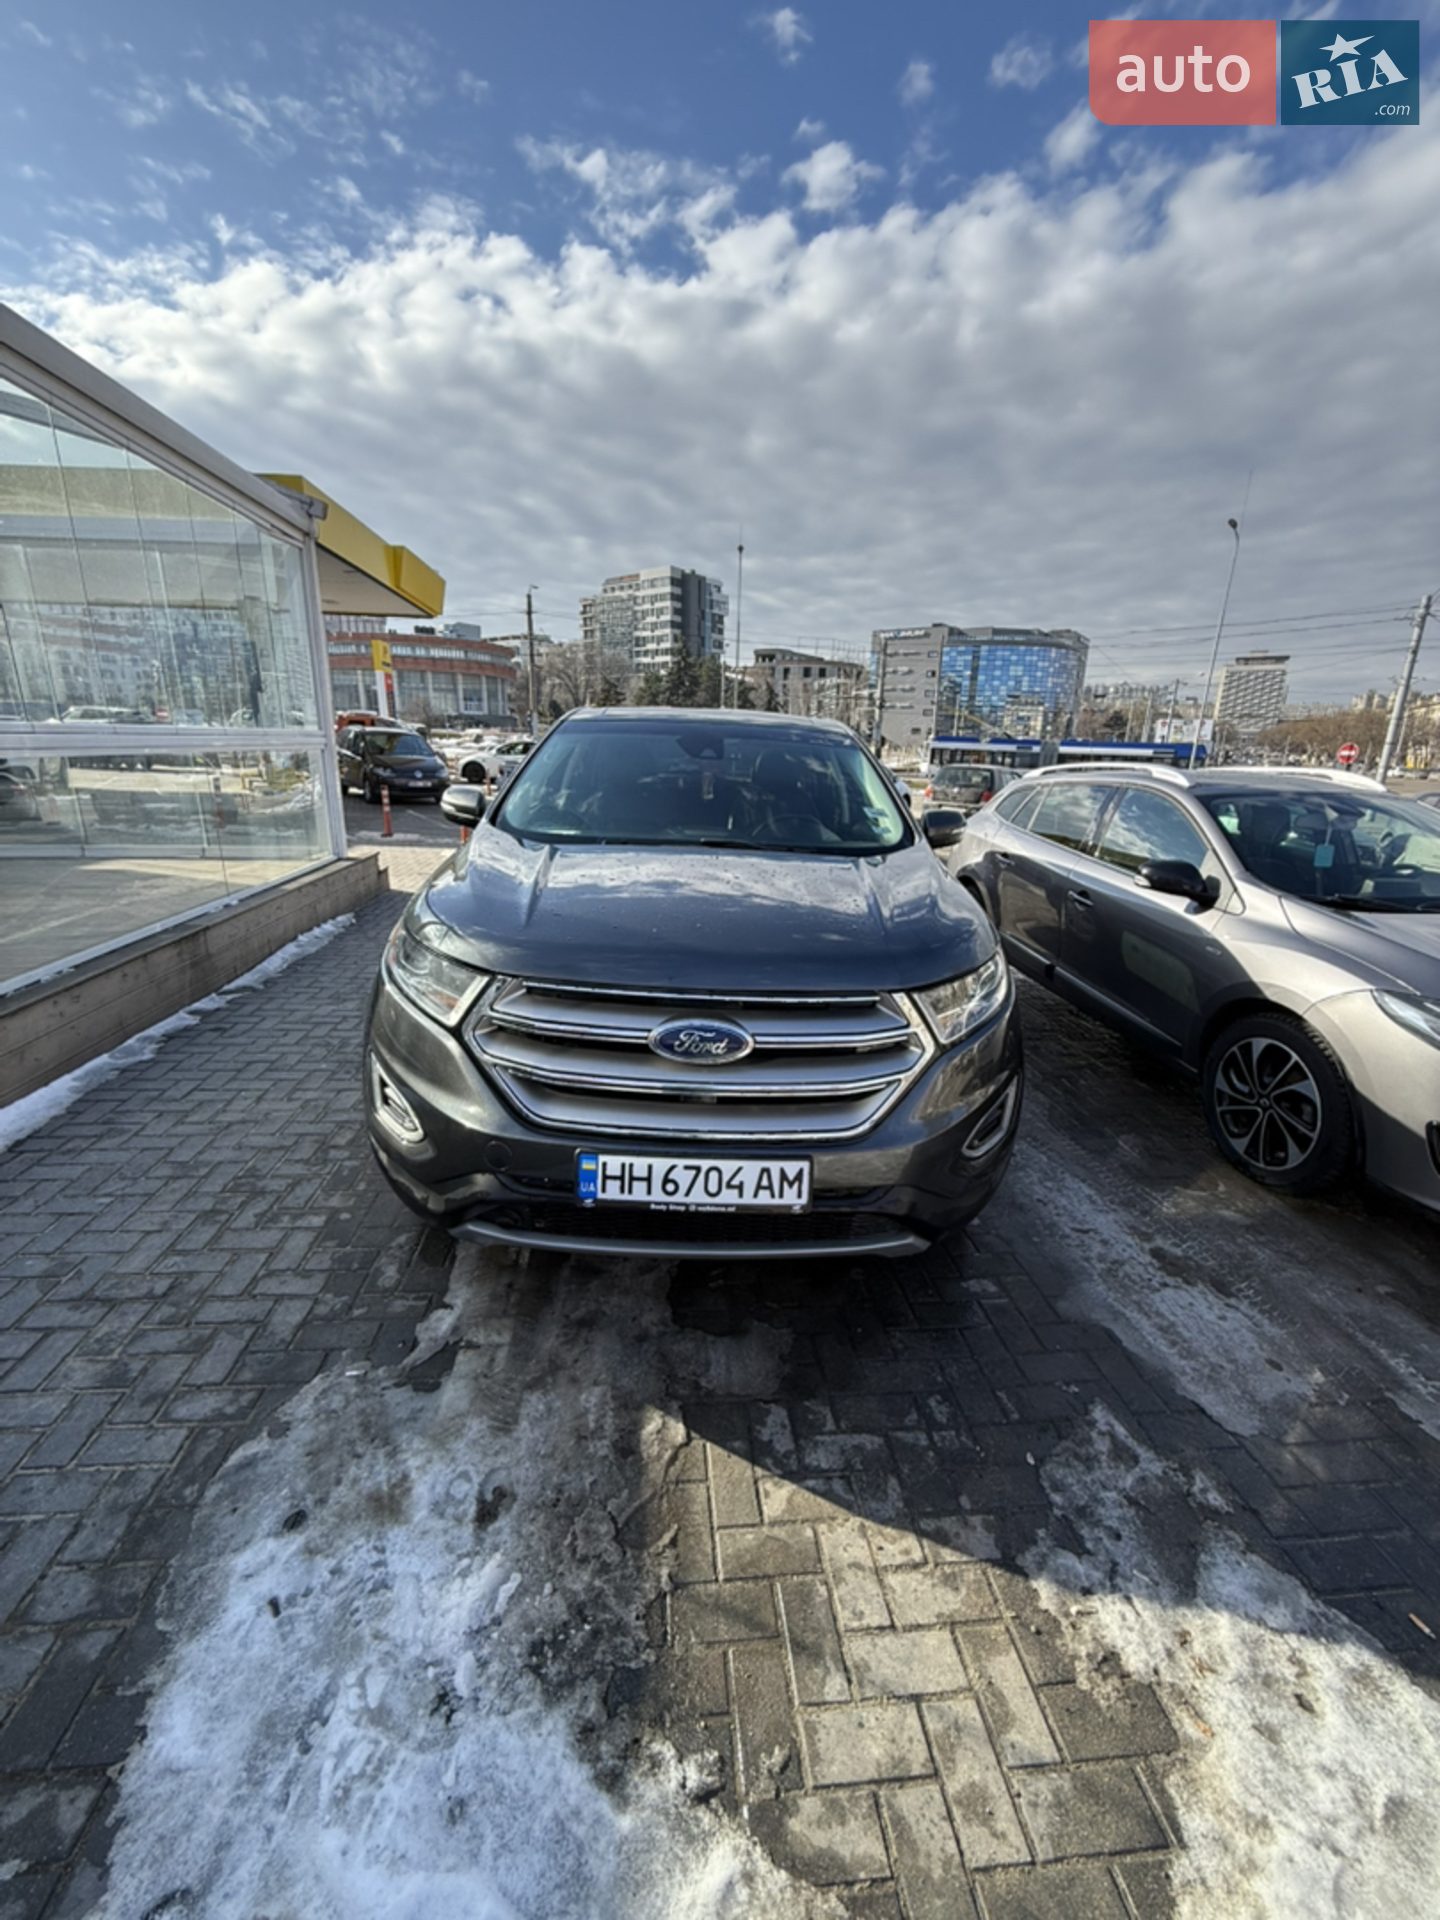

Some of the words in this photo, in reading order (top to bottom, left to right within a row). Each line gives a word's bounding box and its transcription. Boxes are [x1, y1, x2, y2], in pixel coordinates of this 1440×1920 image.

[673, 1029, 729, 1055] Ford
[580, 1182, 596, 1192] UA
[601, 1161, 653, 1196] HH
[661, 1164, 744, 1198] 6704
[753, 1167, 804, 1199] AM
